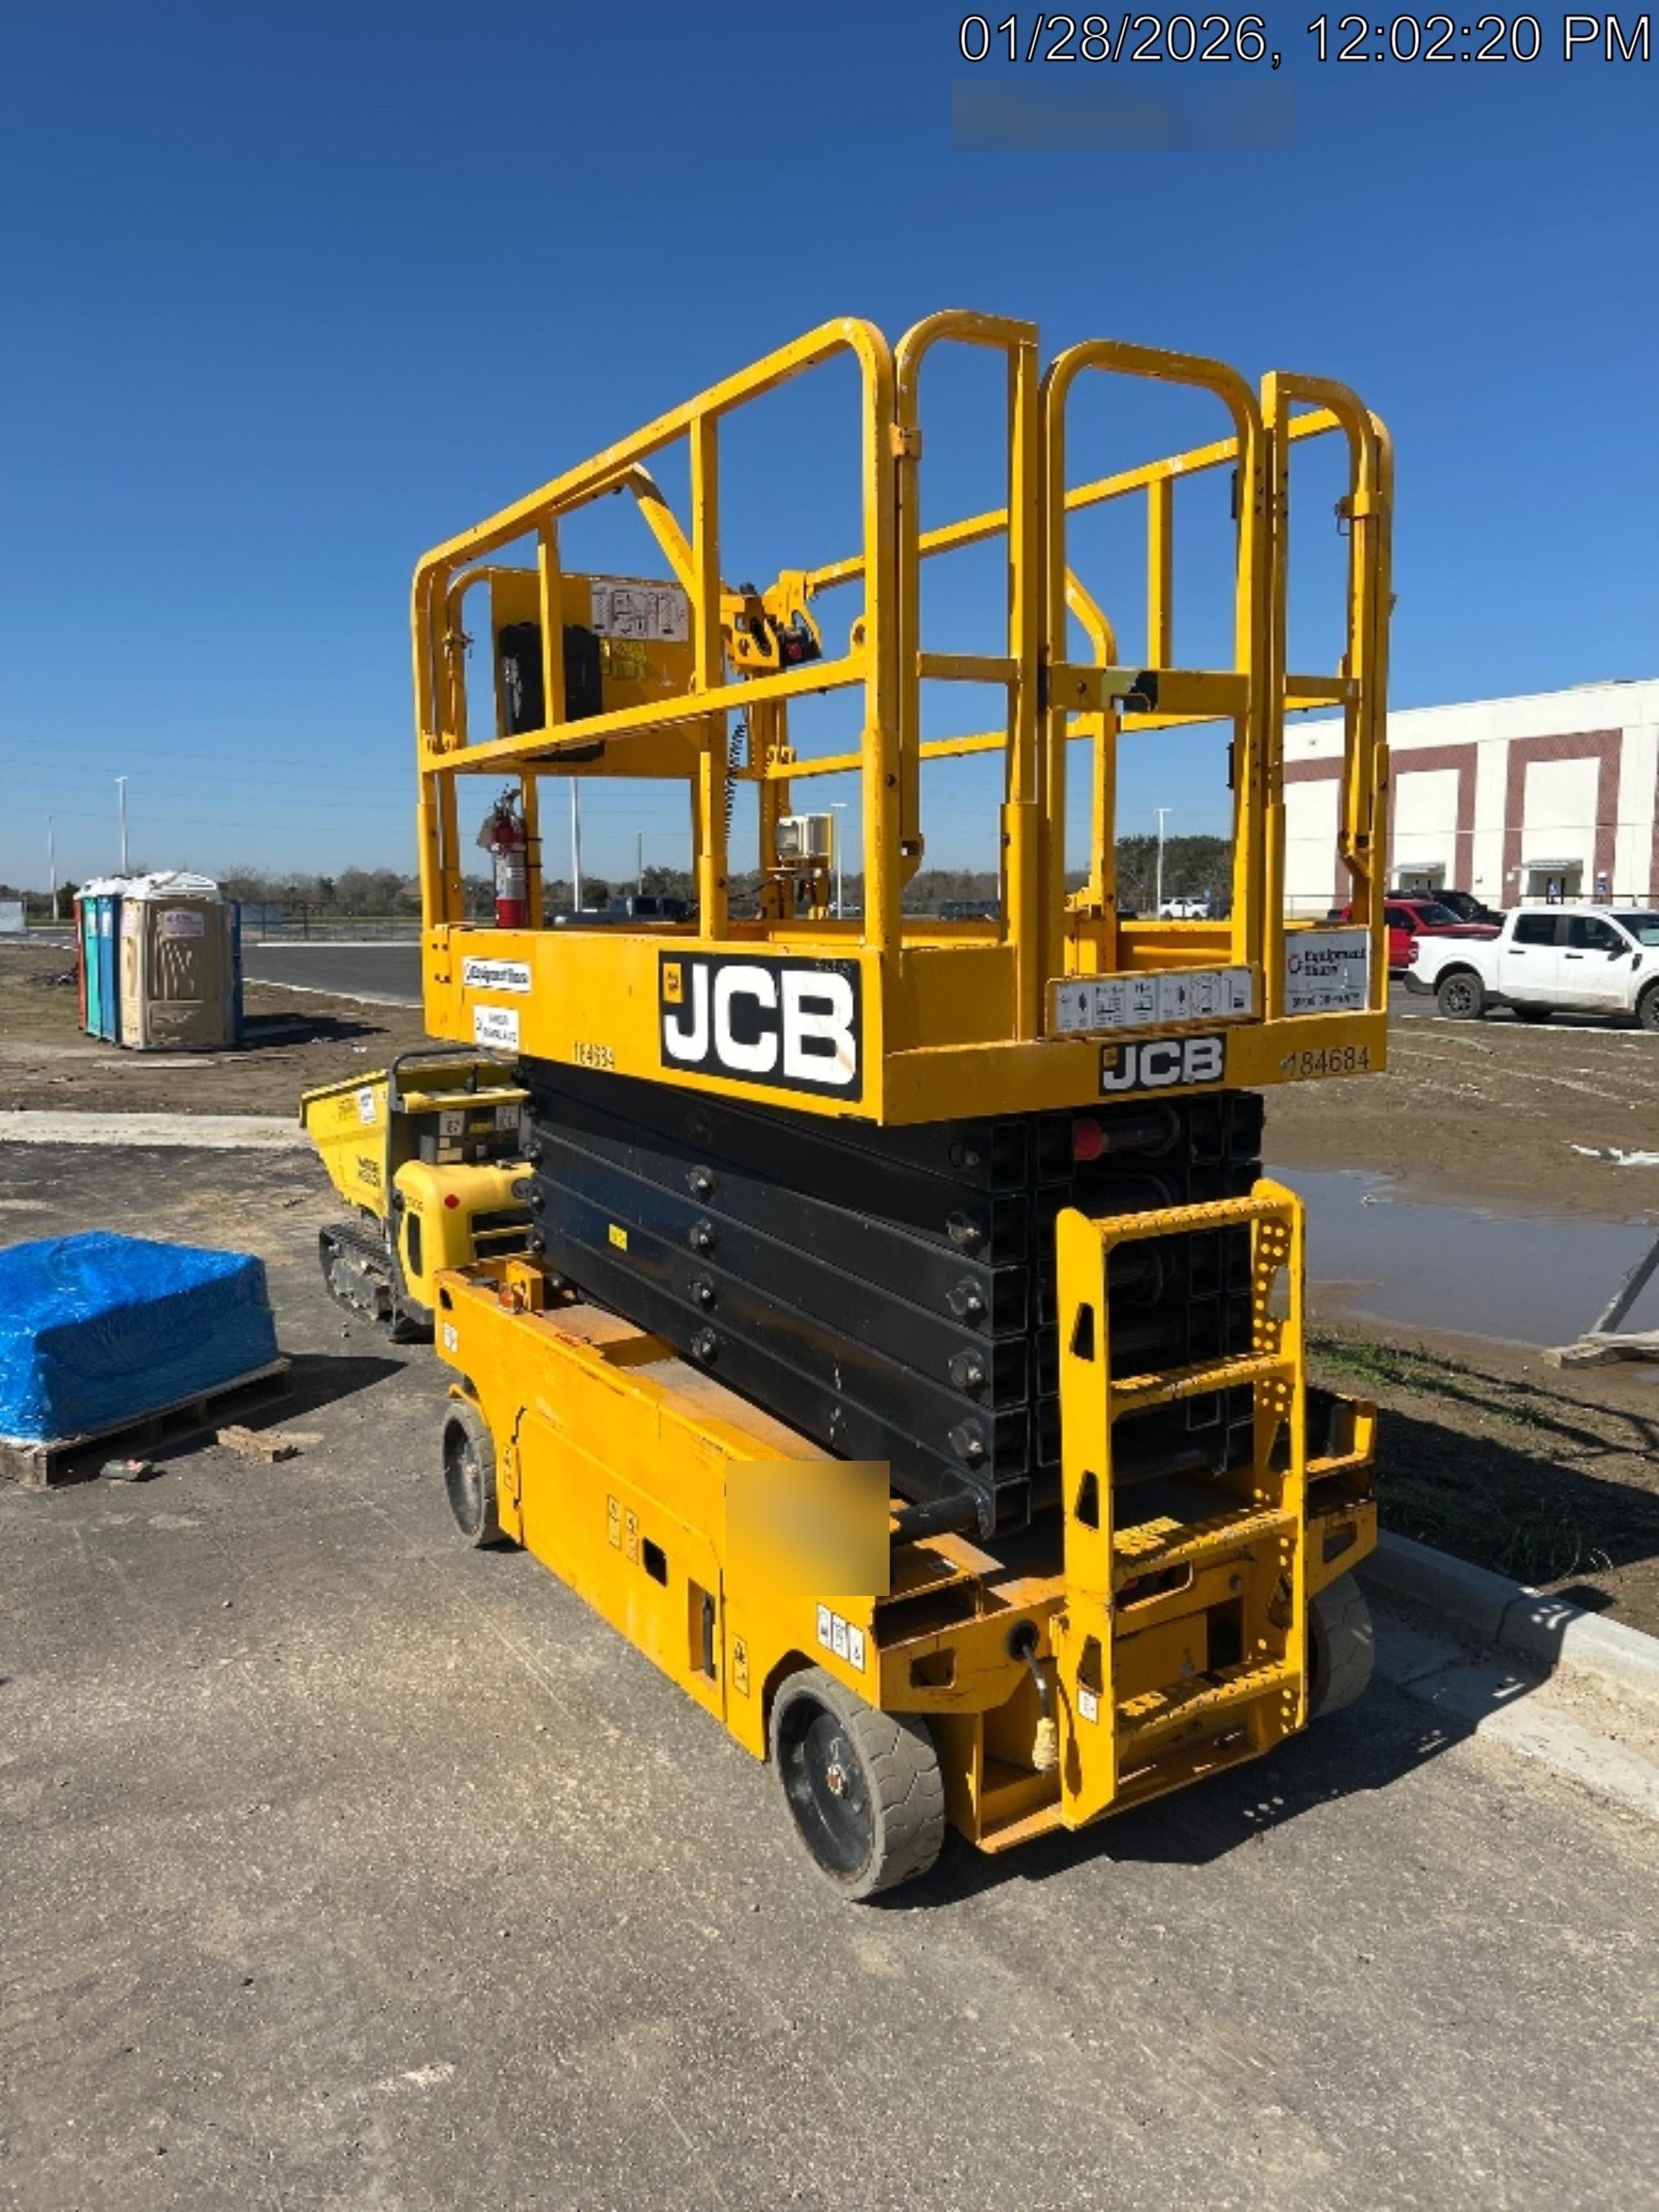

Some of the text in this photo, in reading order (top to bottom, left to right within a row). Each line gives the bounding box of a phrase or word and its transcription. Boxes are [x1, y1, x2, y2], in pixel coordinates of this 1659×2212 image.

[664, 963, 857, 1086] JCB
[1103, 1036, 1223, 1090] JCB
[1286, 1045, 1371, 1077] 184684
